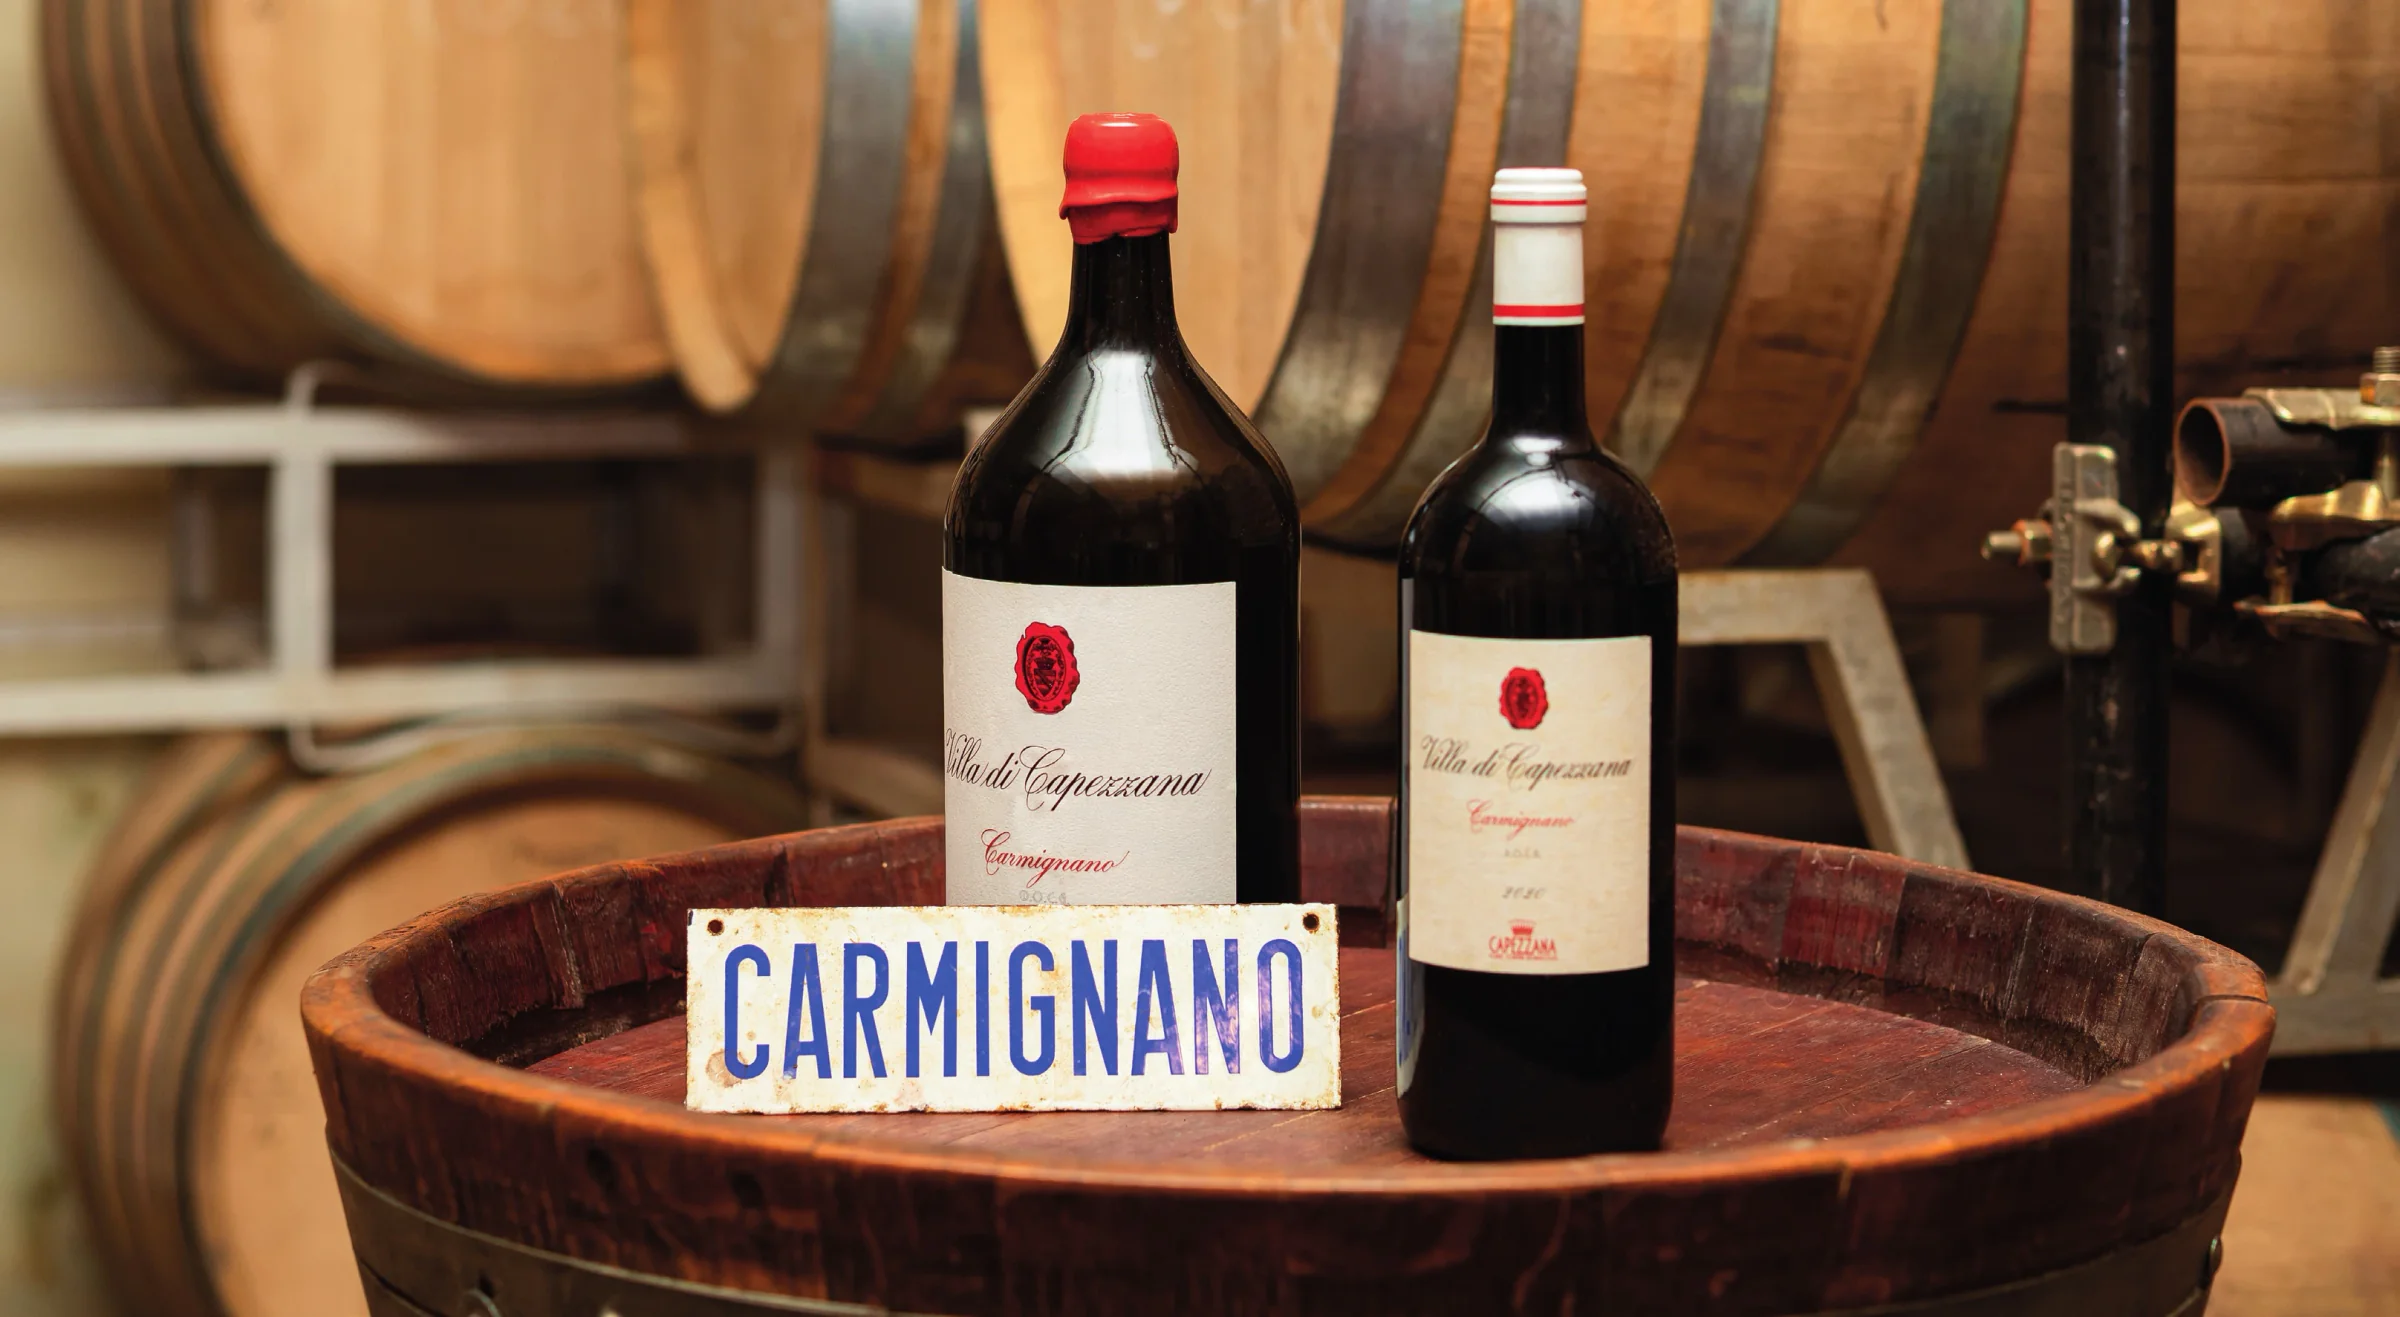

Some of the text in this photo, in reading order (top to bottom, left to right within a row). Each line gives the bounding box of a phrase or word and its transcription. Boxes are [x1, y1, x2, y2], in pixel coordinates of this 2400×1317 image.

[945, 727, 1213, 812] Villa di Capezzana
[1420, 735, 1634, 792] Villa di Capezzana
[1466, 798, 1576, 841] Carmignano
[980, 828, 1130, 888] Carmignano
[1488, 934, 1557, 957] CAPEZZANA
[723, 938, 1304, 1081] CARMIGNANO
